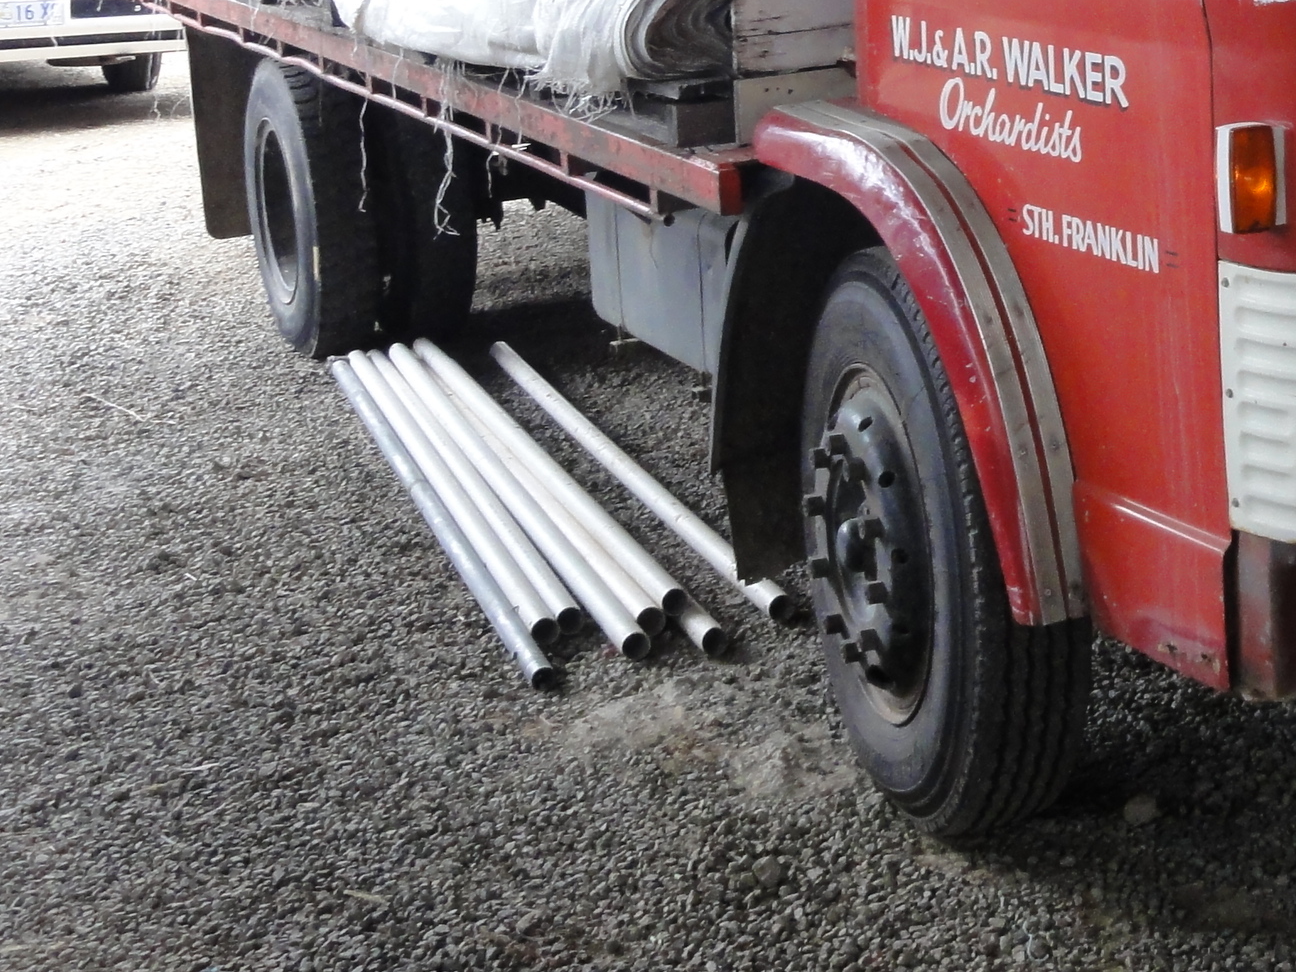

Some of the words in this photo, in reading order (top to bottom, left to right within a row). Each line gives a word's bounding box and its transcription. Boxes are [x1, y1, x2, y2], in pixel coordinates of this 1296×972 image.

[1002, 36, 1129, 108] WALKER
[939, 77, 1082, 163] Orchardists
[1022, 203, 1060, 244] STH.
[1062, 214, 1160, 274] FRANKLIN
